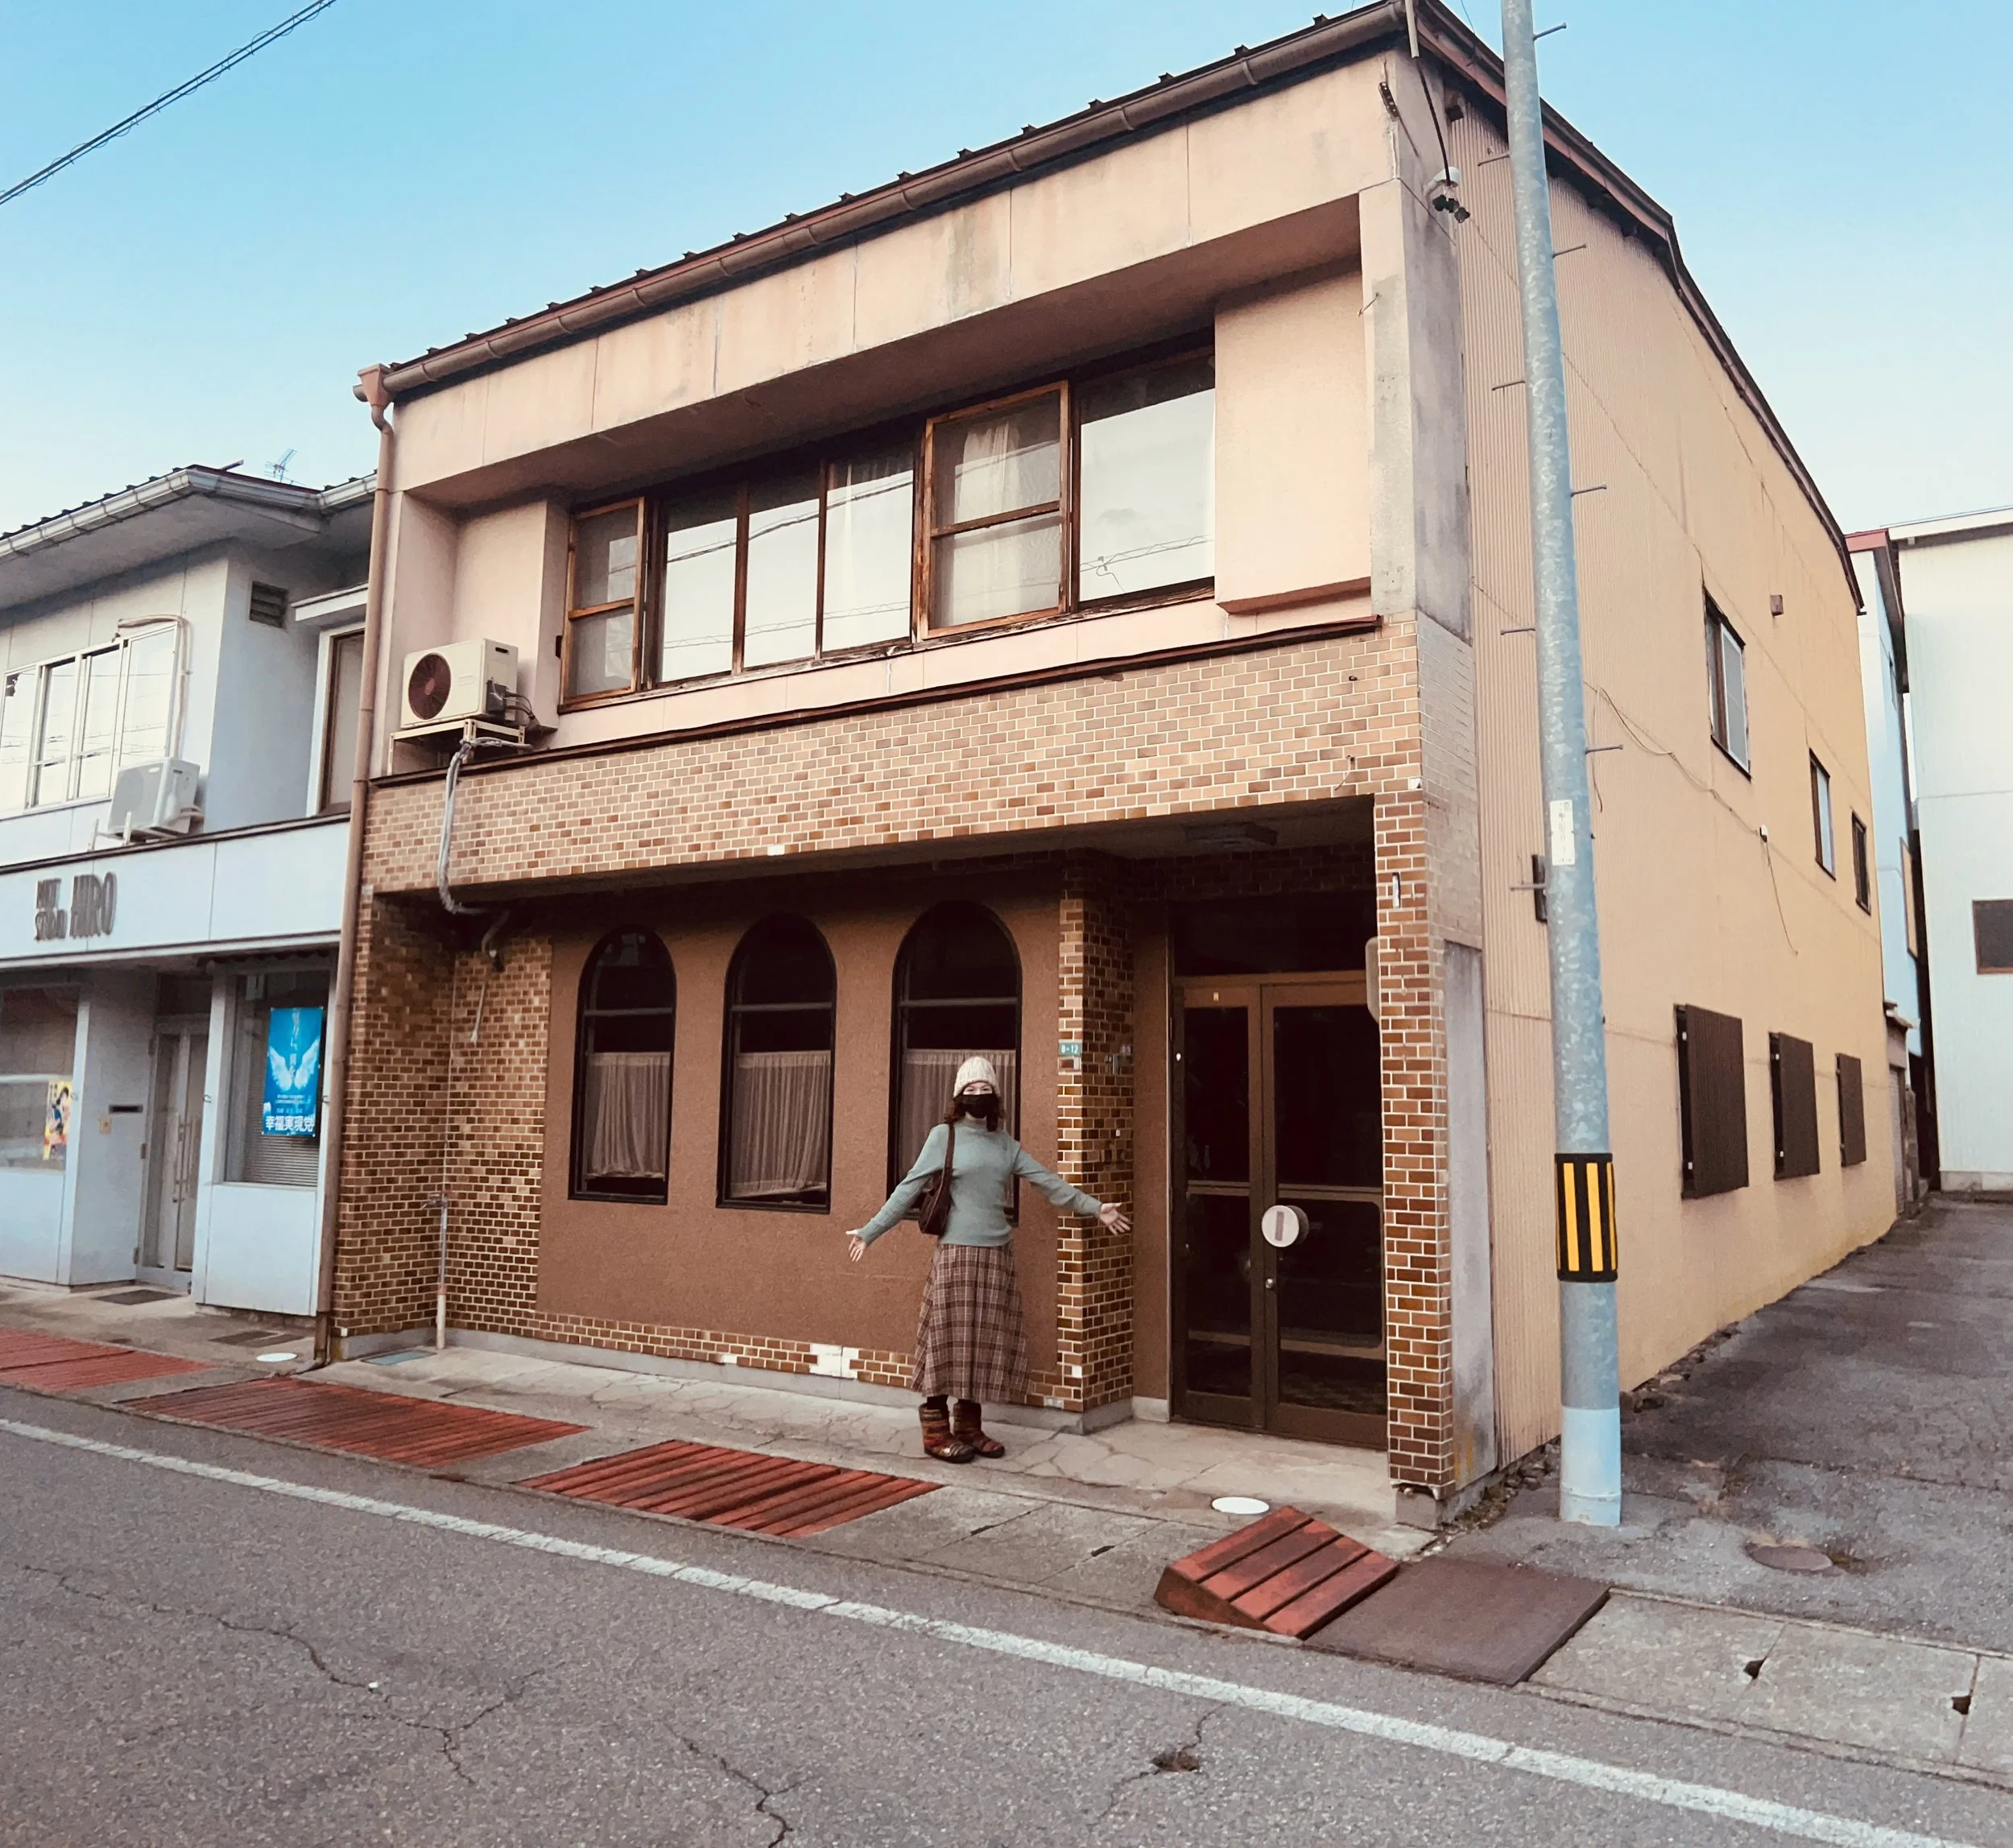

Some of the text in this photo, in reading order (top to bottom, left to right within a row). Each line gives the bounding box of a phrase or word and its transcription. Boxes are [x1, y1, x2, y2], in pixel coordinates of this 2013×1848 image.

[69, 871, 117, 939] HIRO
[266, 1115, 315, 1132] 幸福実現党
